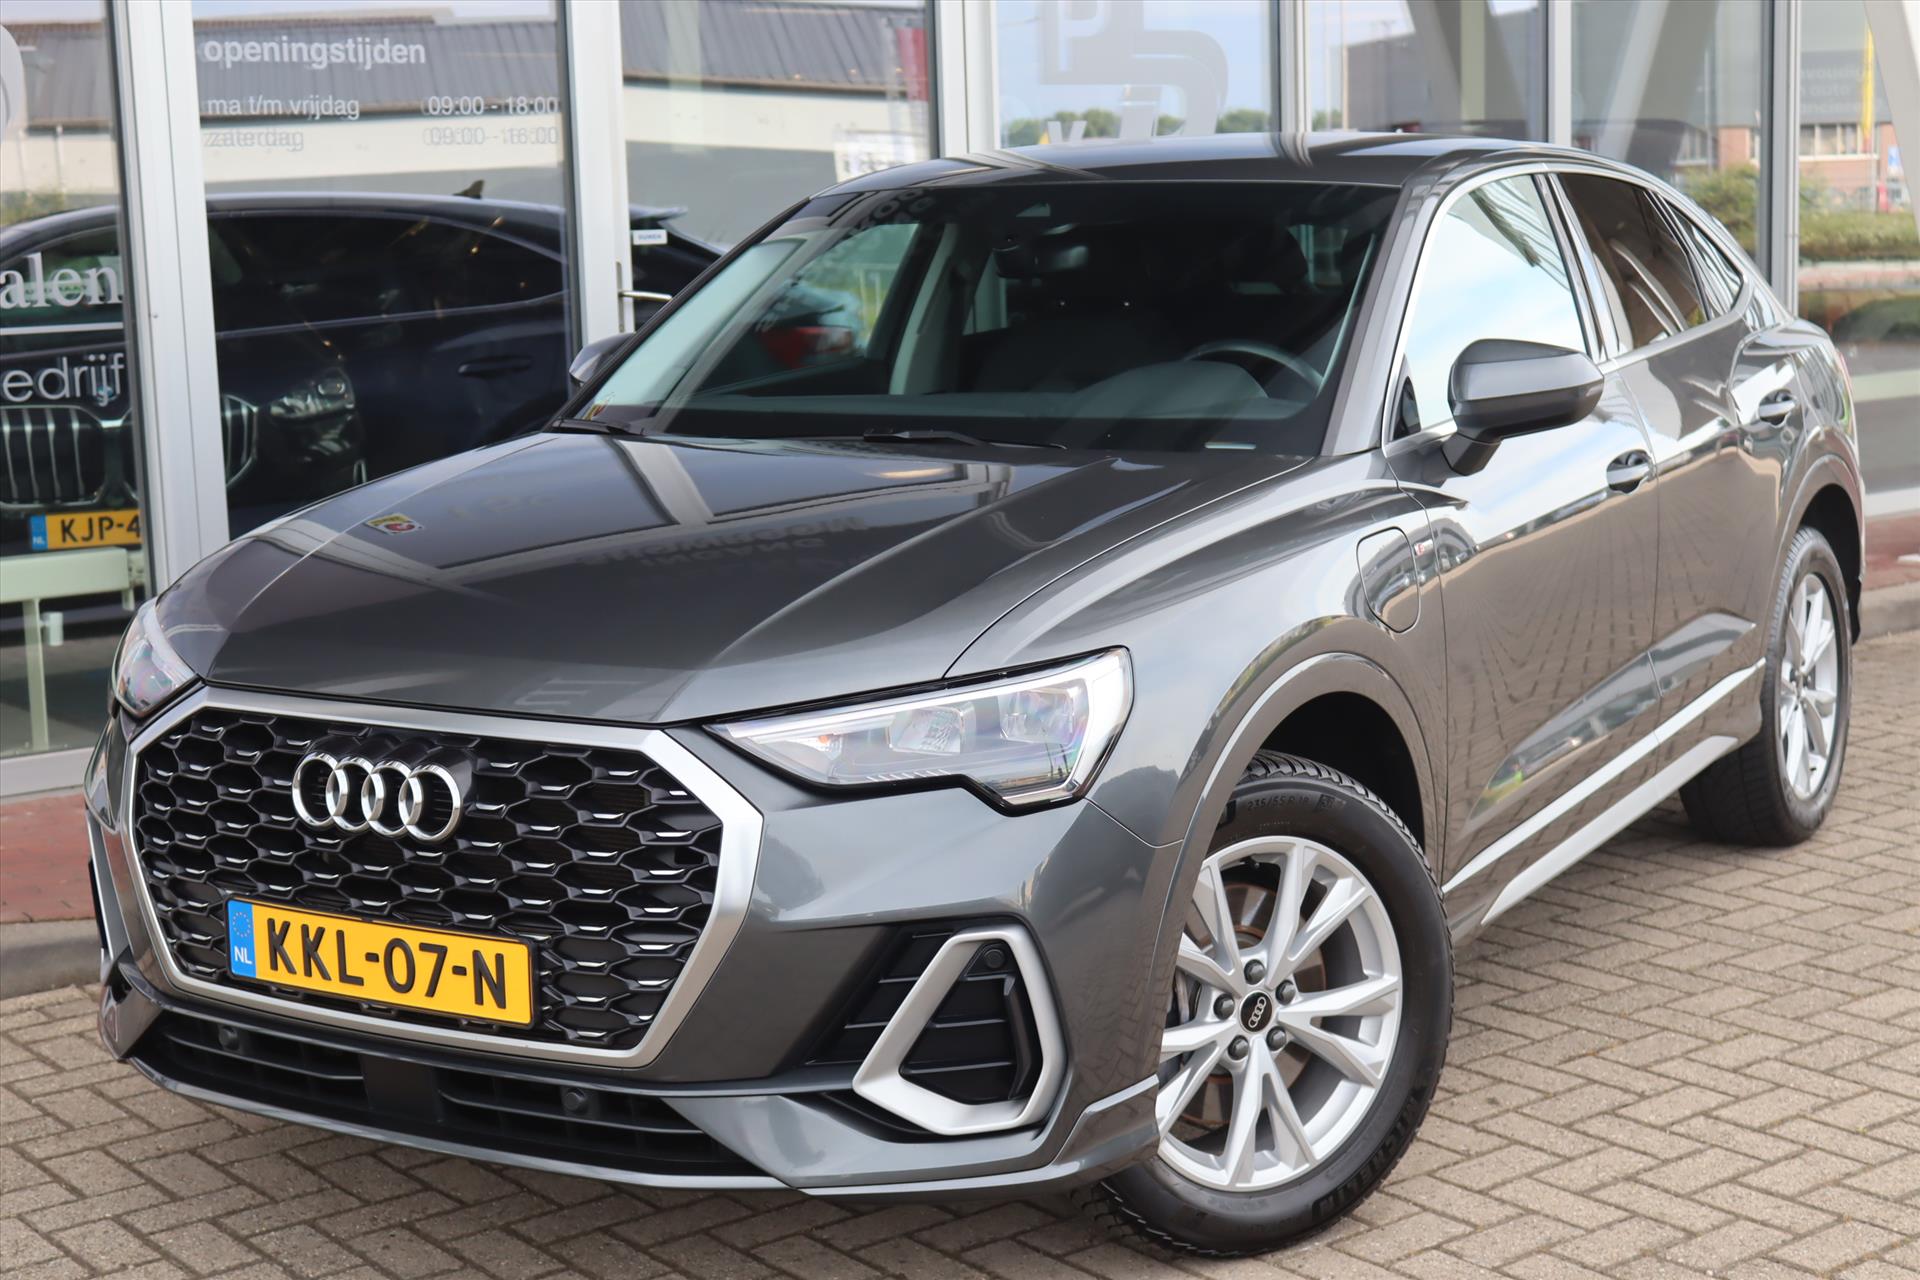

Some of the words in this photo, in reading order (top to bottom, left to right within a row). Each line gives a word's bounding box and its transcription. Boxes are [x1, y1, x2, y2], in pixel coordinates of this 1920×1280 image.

[204, 37, 425, 69] openingstijden
[208, 99, 240, 115] ma
[249, 95, 281, 115] t/m
[290, 95, 359, 120] vrijdag
[428, 96, 484, 115] 09:00
[506, 96, 557, 114] 18:00
[206, 129, 303, 151] zaterdag
[0, 251, 122, 309] alen
[3, 353, 124, 407] edrijf
[234, 945, 253, 965] NL
[267, 918, 506, 1009] KKL-07-N
